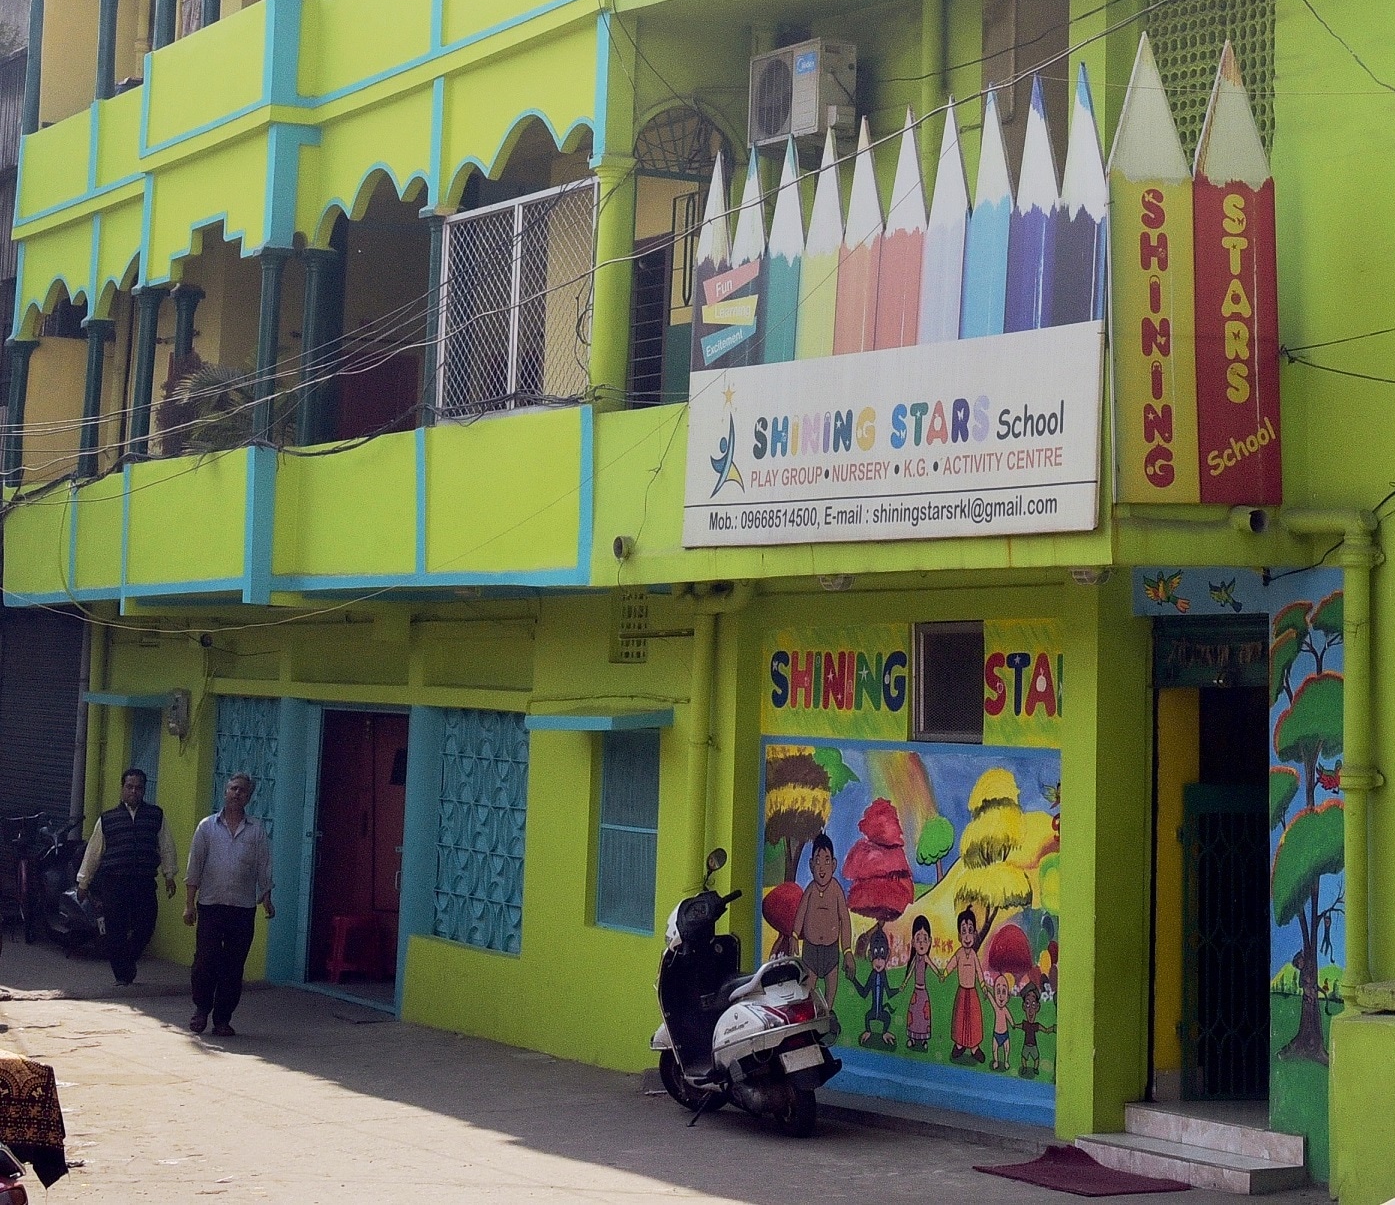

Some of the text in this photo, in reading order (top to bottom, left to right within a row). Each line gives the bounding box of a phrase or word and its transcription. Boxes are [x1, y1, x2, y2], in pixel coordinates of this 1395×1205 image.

[715, 305, 750, 318] Learning
[716, 280, 732, 297] Fun
[1221, 194, 1251, 403] STARS
[706, 330, 743, 356] Excitement
[1140, 188, 1175, 488] SHINING
[752, 395, 1065, 460] SHINING STARS School
[1207, 417, 1277, 477] School
[751, 446, 1063, 488] PLAY GROUP NURSERY K.G. ACTIVITY CENTRE
[740, 506, 820, 529] 09668514500,
[824, 505, 863, 526] E-mail
[873, 495, 1058, 527] shiningstarsrkl@gmail.com
[770, 650, 1063, 717] SHINING STA
